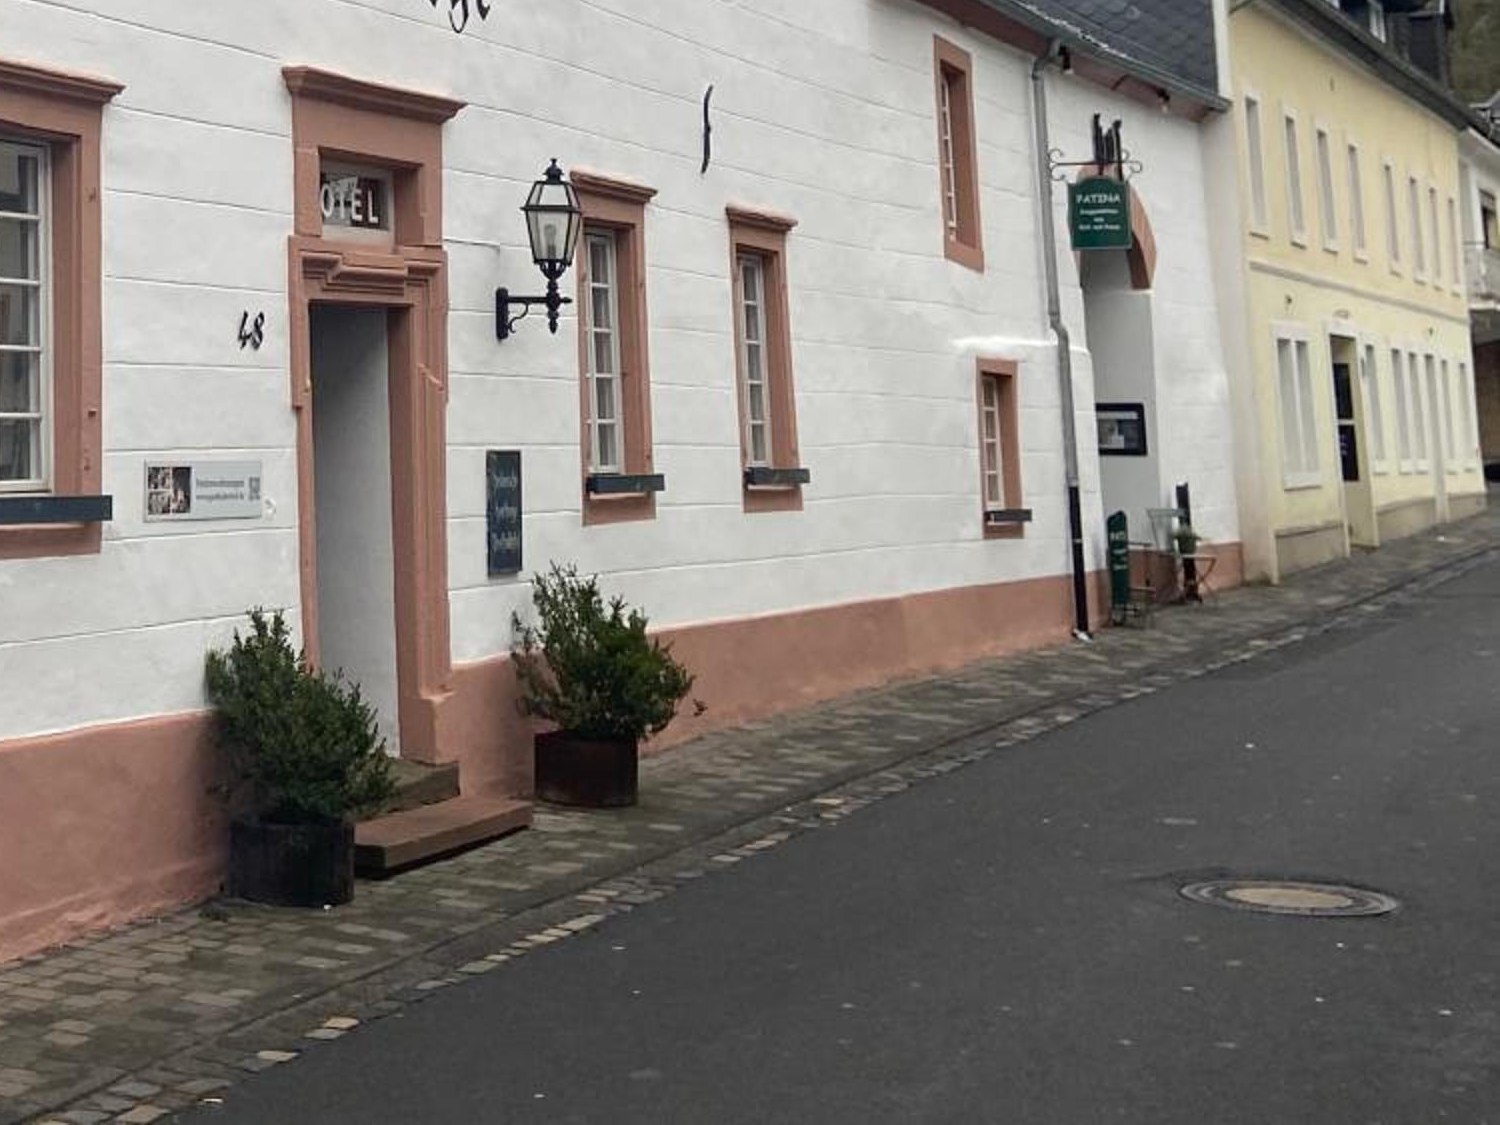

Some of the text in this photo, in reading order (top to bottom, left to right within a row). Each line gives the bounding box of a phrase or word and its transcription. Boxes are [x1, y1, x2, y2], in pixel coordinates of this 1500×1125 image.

[321, 183, 379, 224] OTEL
[1076, 193, 1120, 204] PATINA
[237, 310, 265, 351] 48
